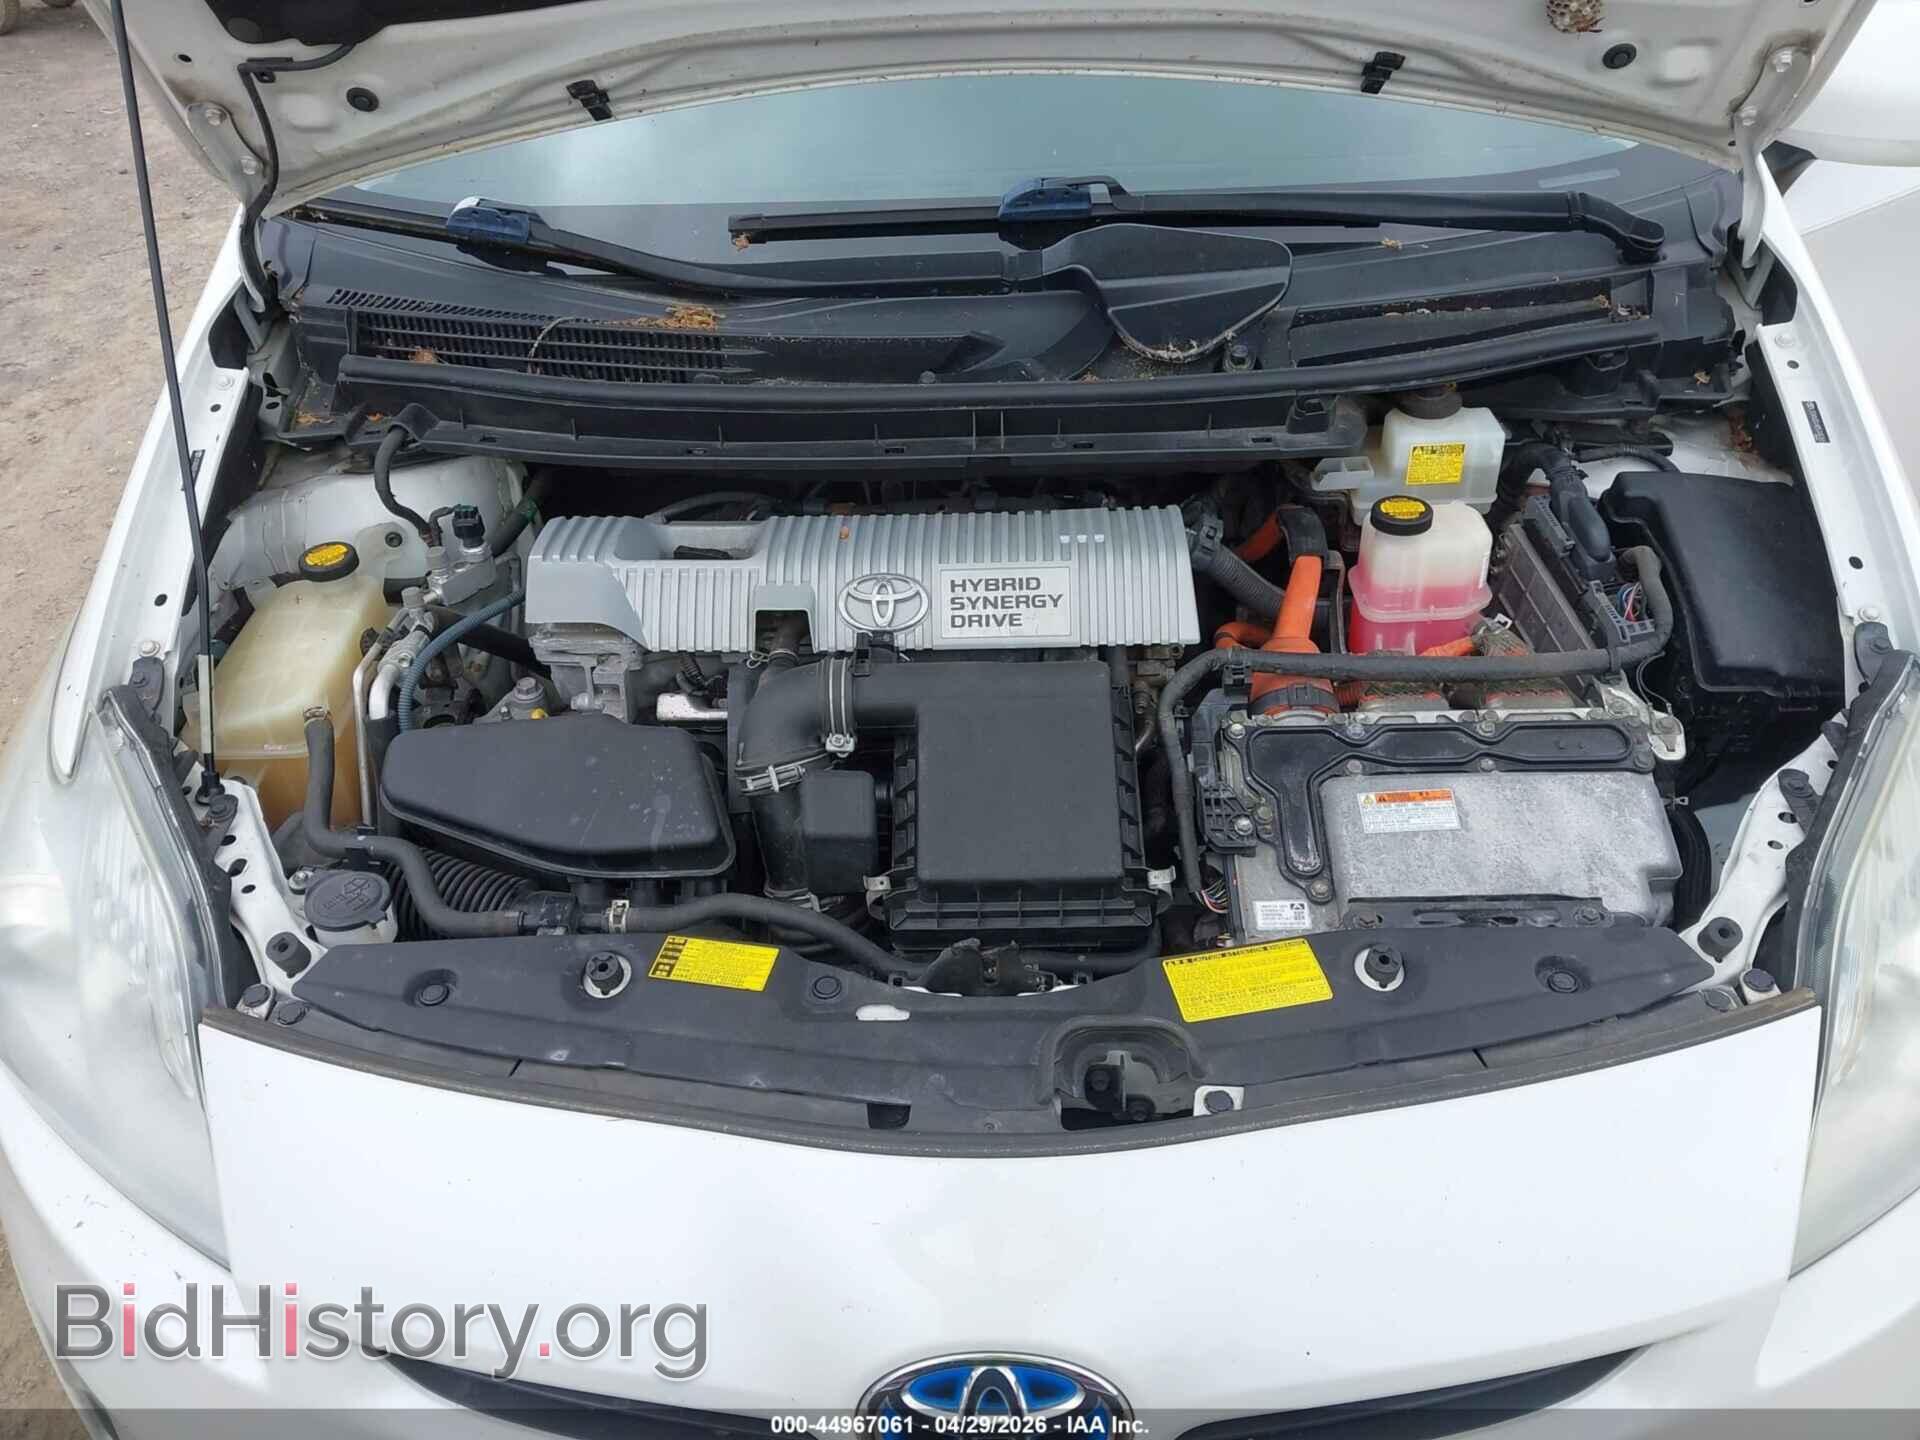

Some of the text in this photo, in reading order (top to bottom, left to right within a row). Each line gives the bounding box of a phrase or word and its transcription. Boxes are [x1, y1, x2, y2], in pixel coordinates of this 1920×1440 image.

[950, 577, 1041, 593] HYBRID
[950, 593, 1064, 611] SYNERGY
[950, 613, 1023, 628] DRIVE
